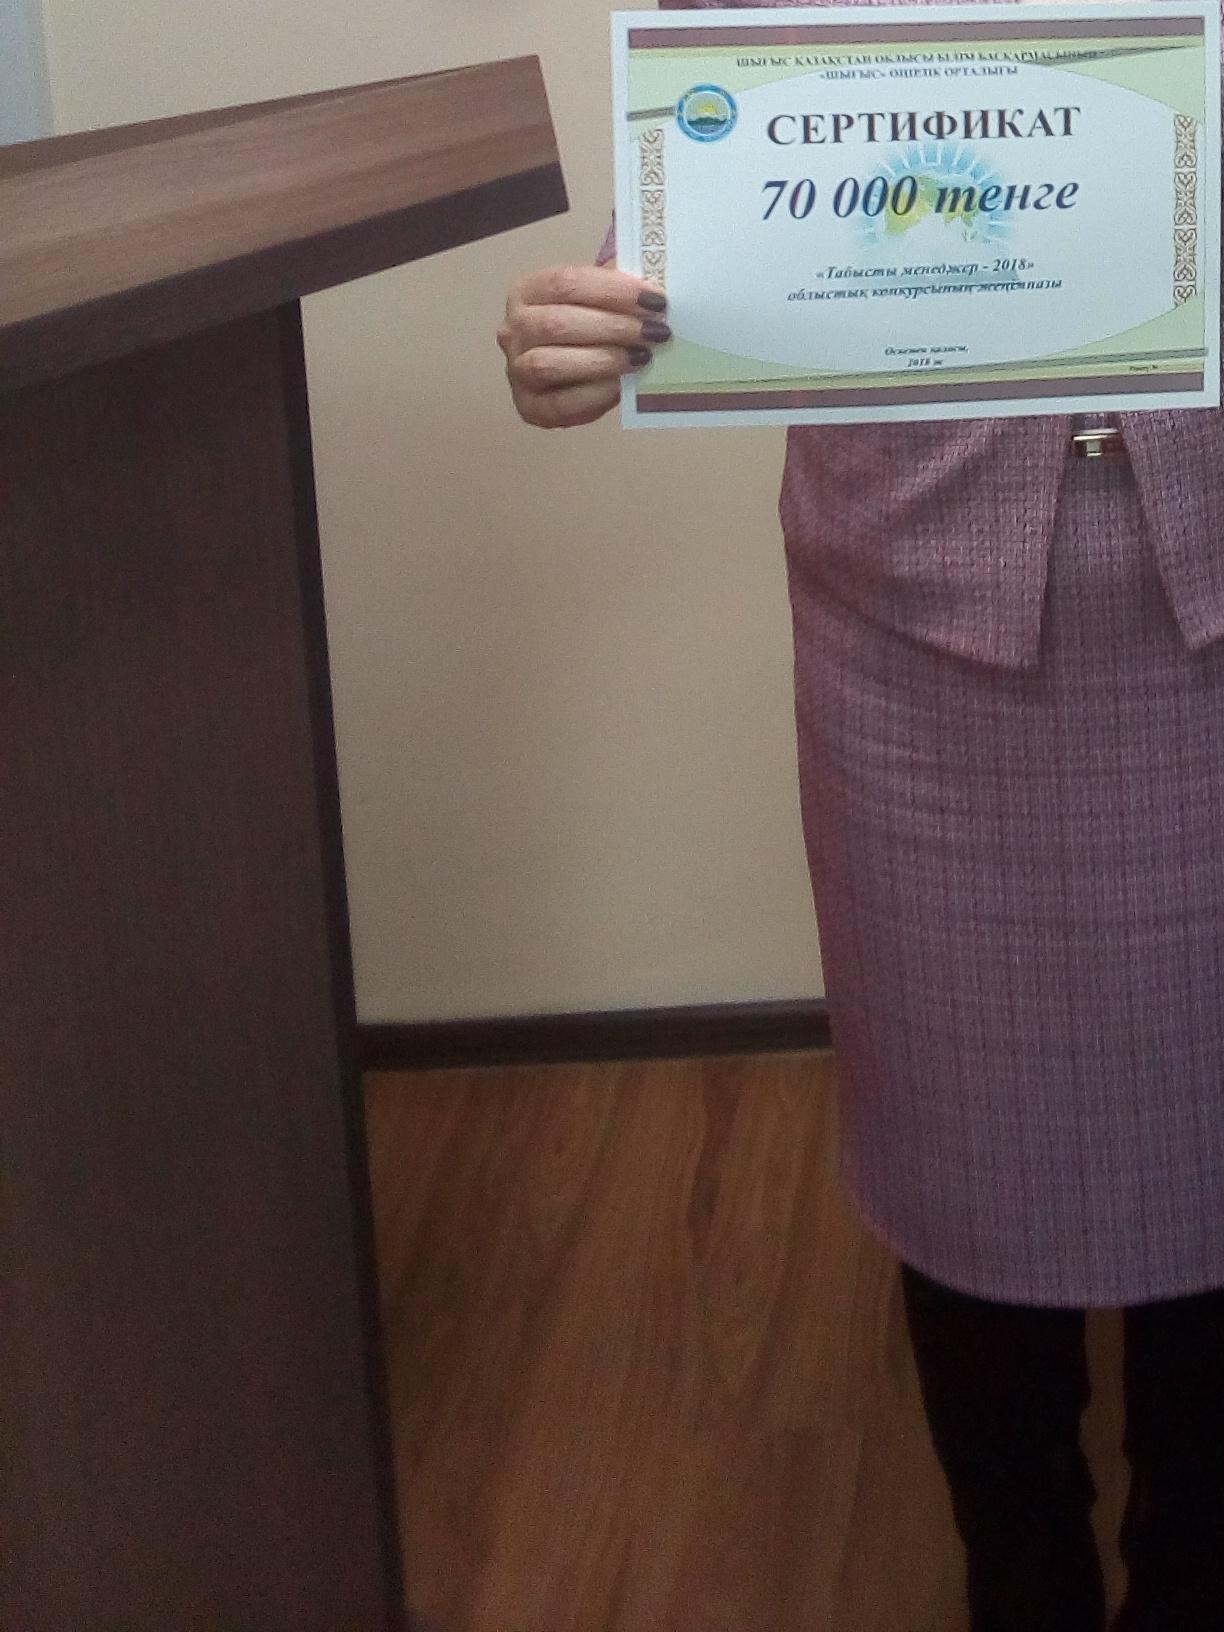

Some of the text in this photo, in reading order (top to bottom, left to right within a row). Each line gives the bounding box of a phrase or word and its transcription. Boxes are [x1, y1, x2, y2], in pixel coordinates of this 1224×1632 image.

[766, 106, 1081, 146] СЕРТИФИКАТ
[760, 175, 1080, 222] 70 000 тенге
[991, 258, 1035, 273] 2018»
